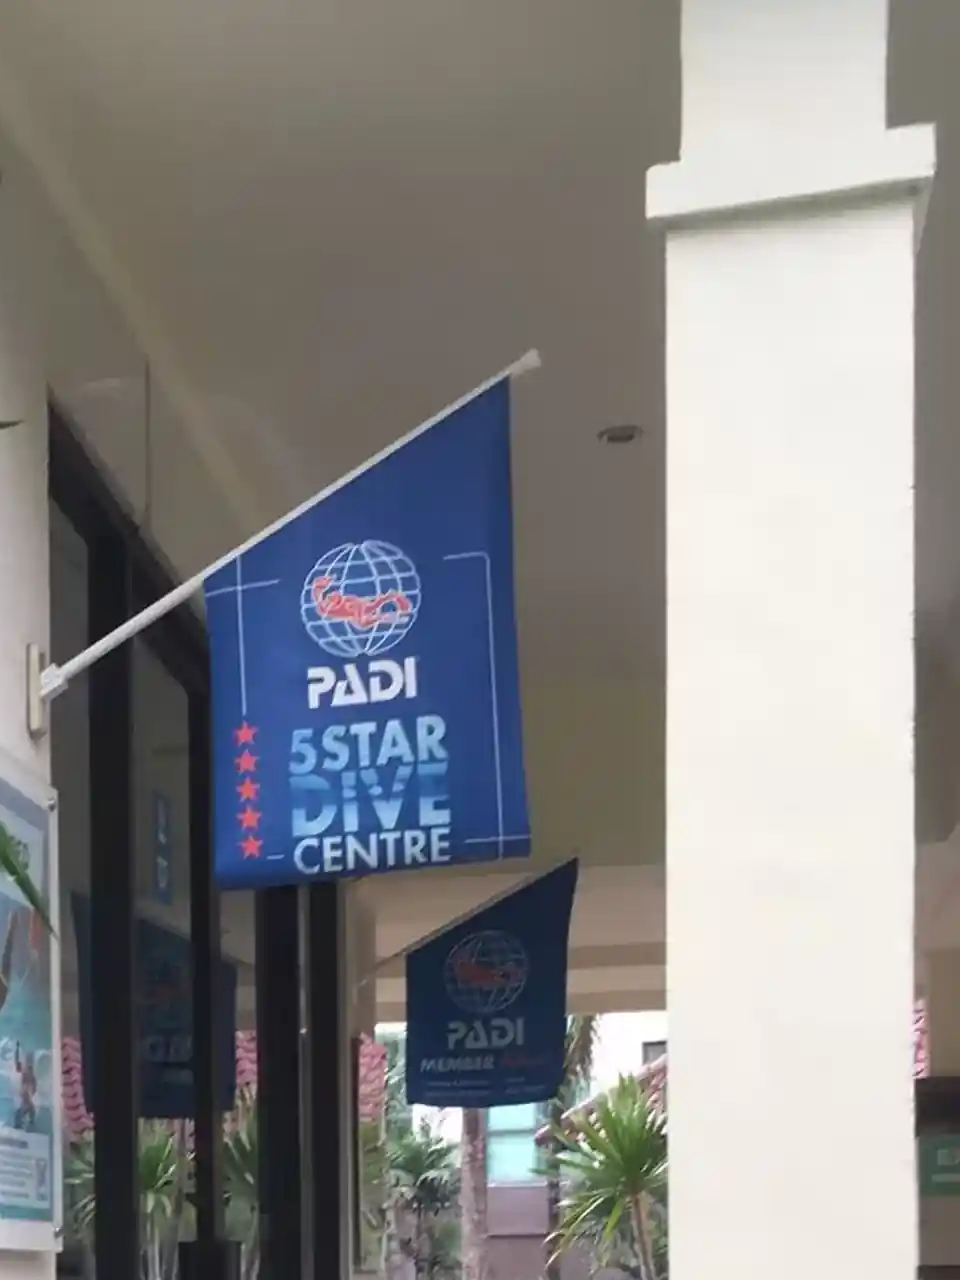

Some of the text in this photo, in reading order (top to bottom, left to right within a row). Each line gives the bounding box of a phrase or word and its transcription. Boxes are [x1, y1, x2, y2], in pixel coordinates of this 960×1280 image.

[307, 656, 417, 709] PADI
[293, 826, 452, 875] CENTRE
[446, 1017, 525, 1050] PADI
